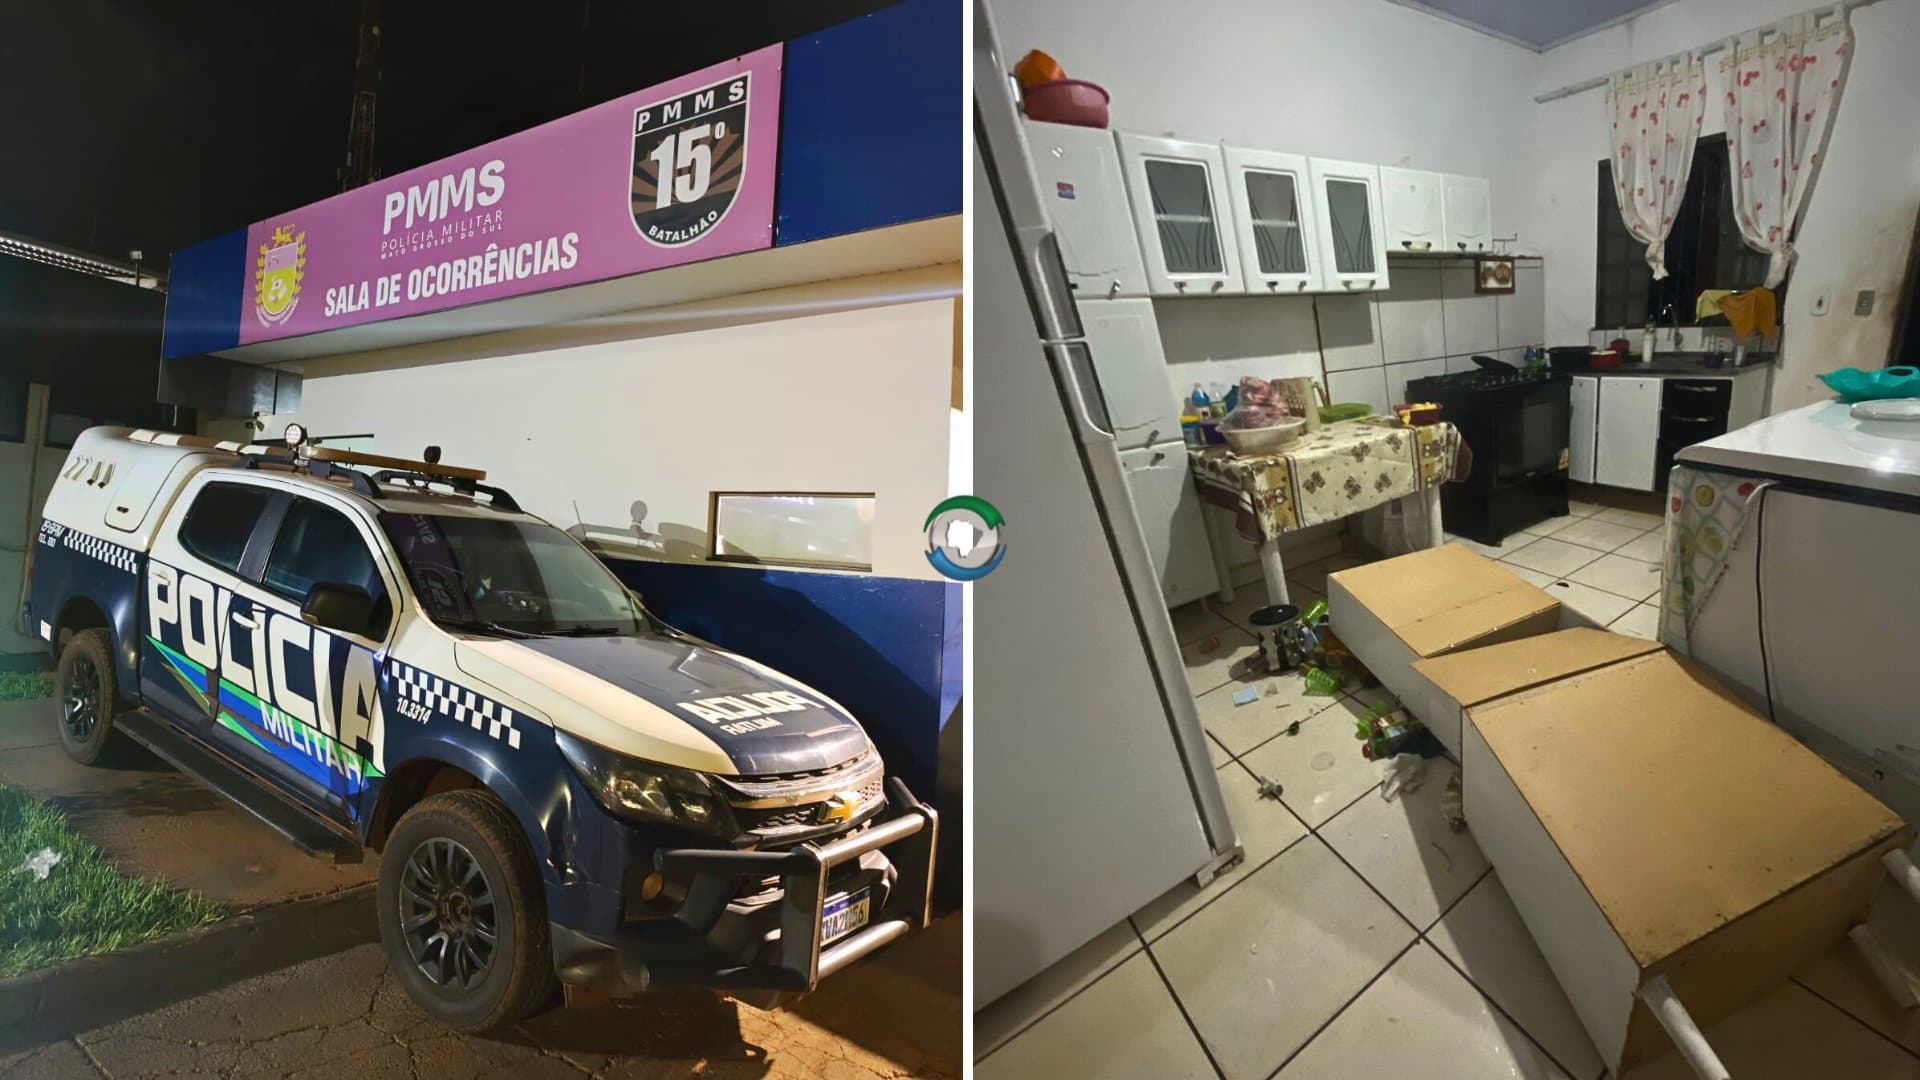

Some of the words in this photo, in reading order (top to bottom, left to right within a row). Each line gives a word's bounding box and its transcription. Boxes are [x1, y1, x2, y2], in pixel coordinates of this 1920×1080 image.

[638, 81, 744, 131] PMMS
[383, 159, 505, 235] PMMS
[381, 229, 434, 252] POLÍCIA
[442, 210, 503, 237] MILITAR
[381, 249, 406, 260] MATO
[412, 236, 453, 252] GROSSO
[460, 231, 474, 240] DO
[482, 223, 502, 235] SUL
[648, 210, 718, 242] BATALHÃO
[324, 281, 370, 317] SALA
[375, 273, 402, 307] DE
[407, 232, 579, 301] OCORRÊNCIAS
[147, 563, 386, 774] POLÍCIA
[396, 697, 432, 724] 10.3314
[259, 699, 365, 786] MILITAR
